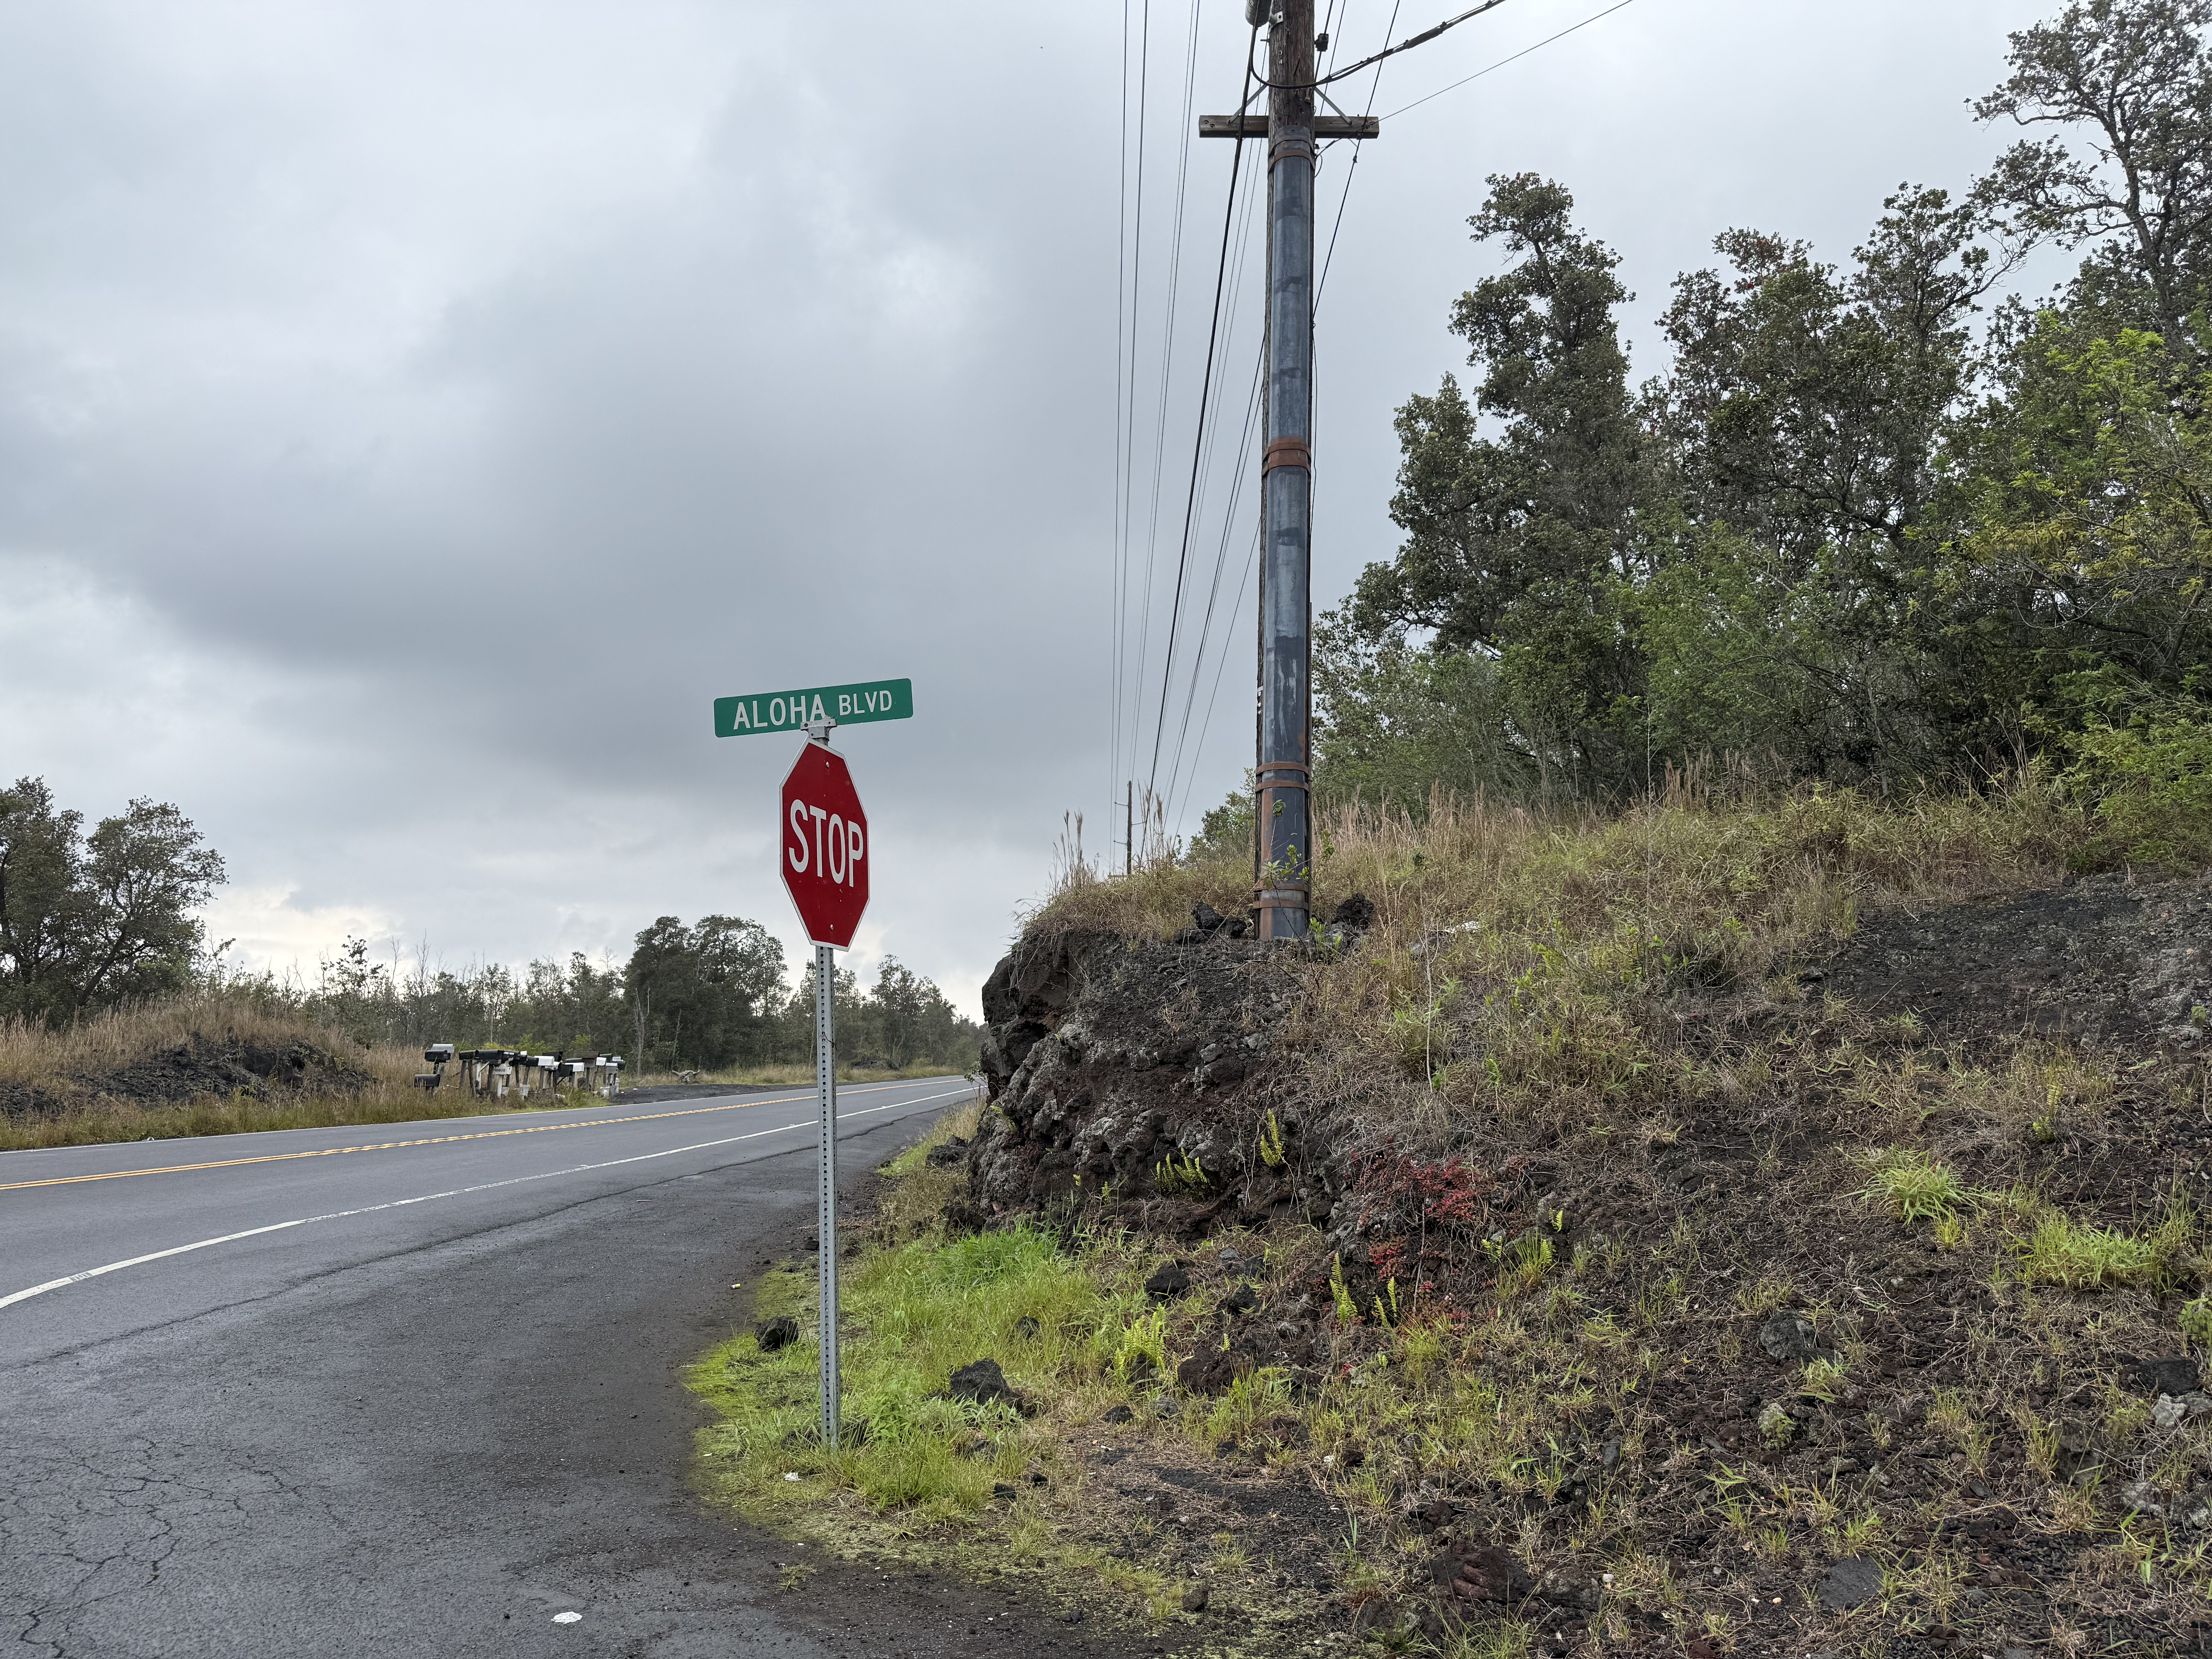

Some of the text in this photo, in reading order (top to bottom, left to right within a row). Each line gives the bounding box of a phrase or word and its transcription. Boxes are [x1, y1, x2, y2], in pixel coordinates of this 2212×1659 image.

[733, 690, 892, 729] ALOHA BLVD
[789, 799, 863, 887] STOP
